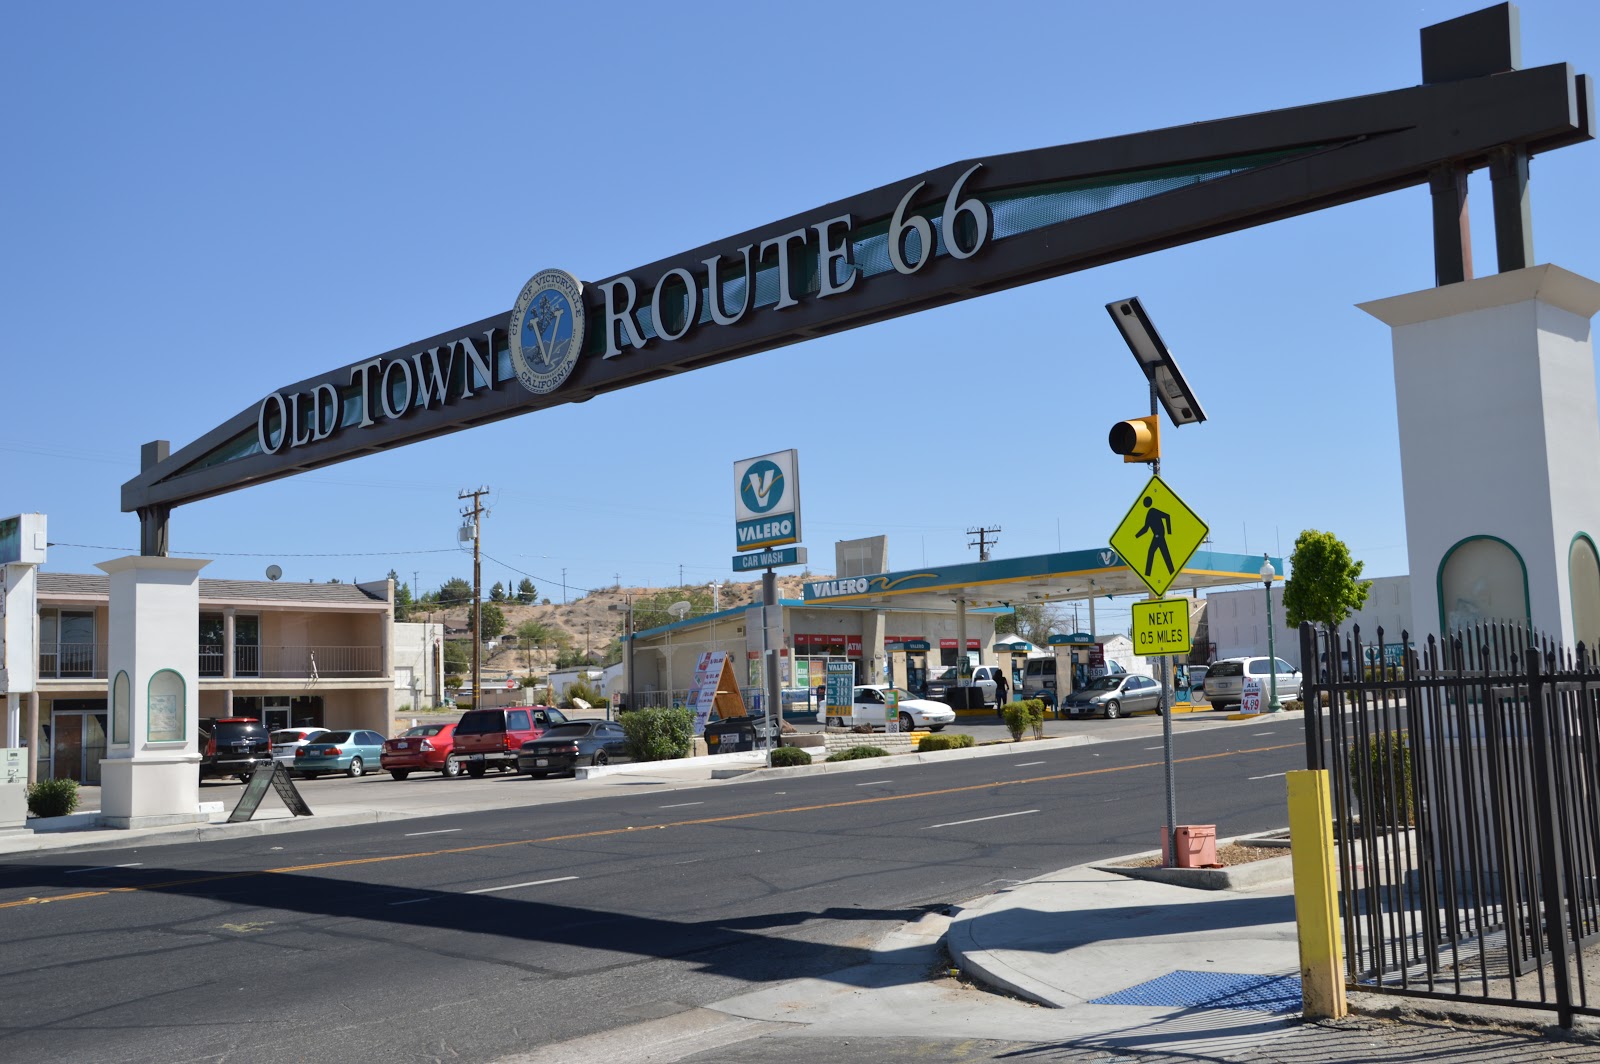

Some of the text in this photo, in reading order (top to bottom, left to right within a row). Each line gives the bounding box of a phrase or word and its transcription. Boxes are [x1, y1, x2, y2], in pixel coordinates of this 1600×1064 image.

[258, 162, 990, 455] OLD TOWN ROUTE 66
[512, 274, 581, 336] CITY OF VICTORVILLE
[530, 309, 564, 366] V
[521, 359, 574, 389] CALIFORNIA
[738, 520, 792, 542] VALERO
[742, 551, 784, 568] CAR WASH
[812, 578, 869, 598] VALERO
[1148, 611, 1174, 626] NEXT
[848, 643, 862, 651] ATM
[1140, 629, 1183, 645] 0.5 MILES
